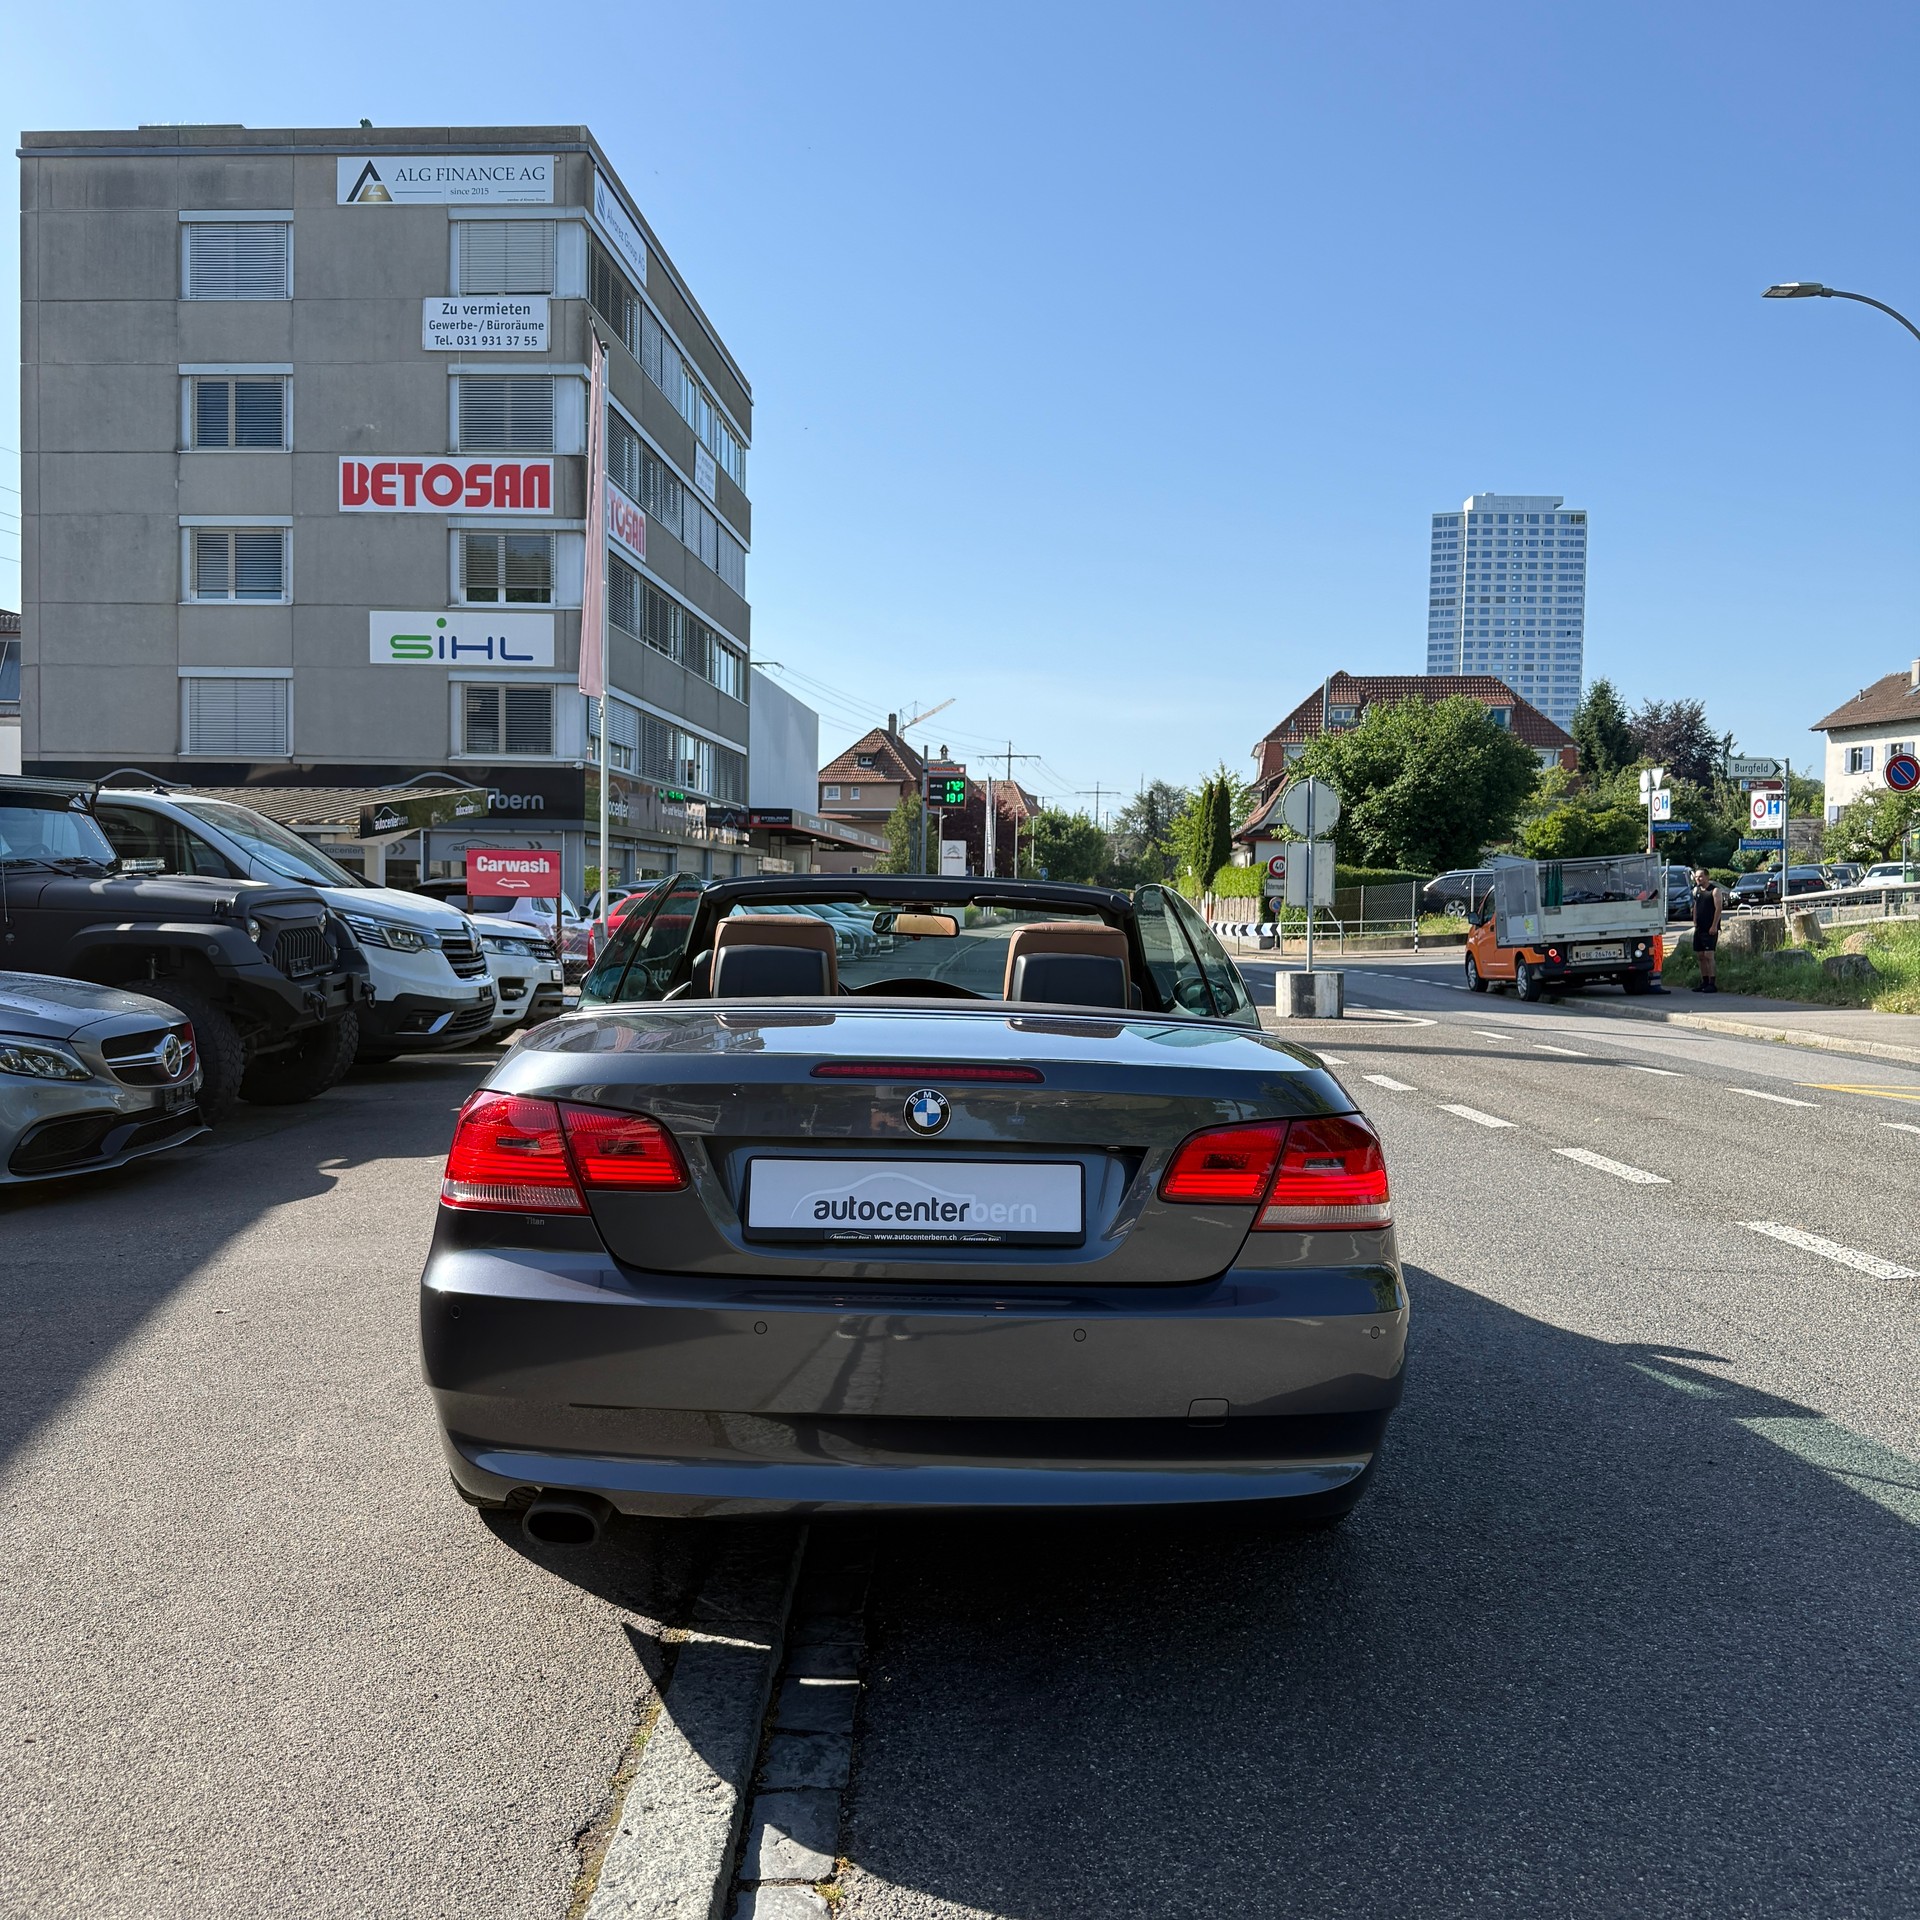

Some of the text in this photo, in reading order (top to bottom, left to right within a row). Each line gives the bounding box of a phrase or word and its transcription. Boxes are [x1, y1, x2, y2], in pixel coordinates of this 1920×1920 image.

[395, 166, 545, 182] ALG FINANCE AG
[450, 187, 489, 195] since 2015
[442, 302, 531, 315] Zu vermieten
[435, 335, 538, 346] Tel. 031 931 37 55
[342, 462, 550, 509] BETOSAN
[607, 486, 645, 557] TOSAN
[1734, 763, 1769, 775] Burgfeld
[487, 789, 544, 810] rbern
[476, 855, 550, 873] Carwash
[1275, 862, 1284, 870] 40
[910, 1091, 946, 1106] BMW
[874, 1233, 957, 1241] www.autocenterbern.ch
